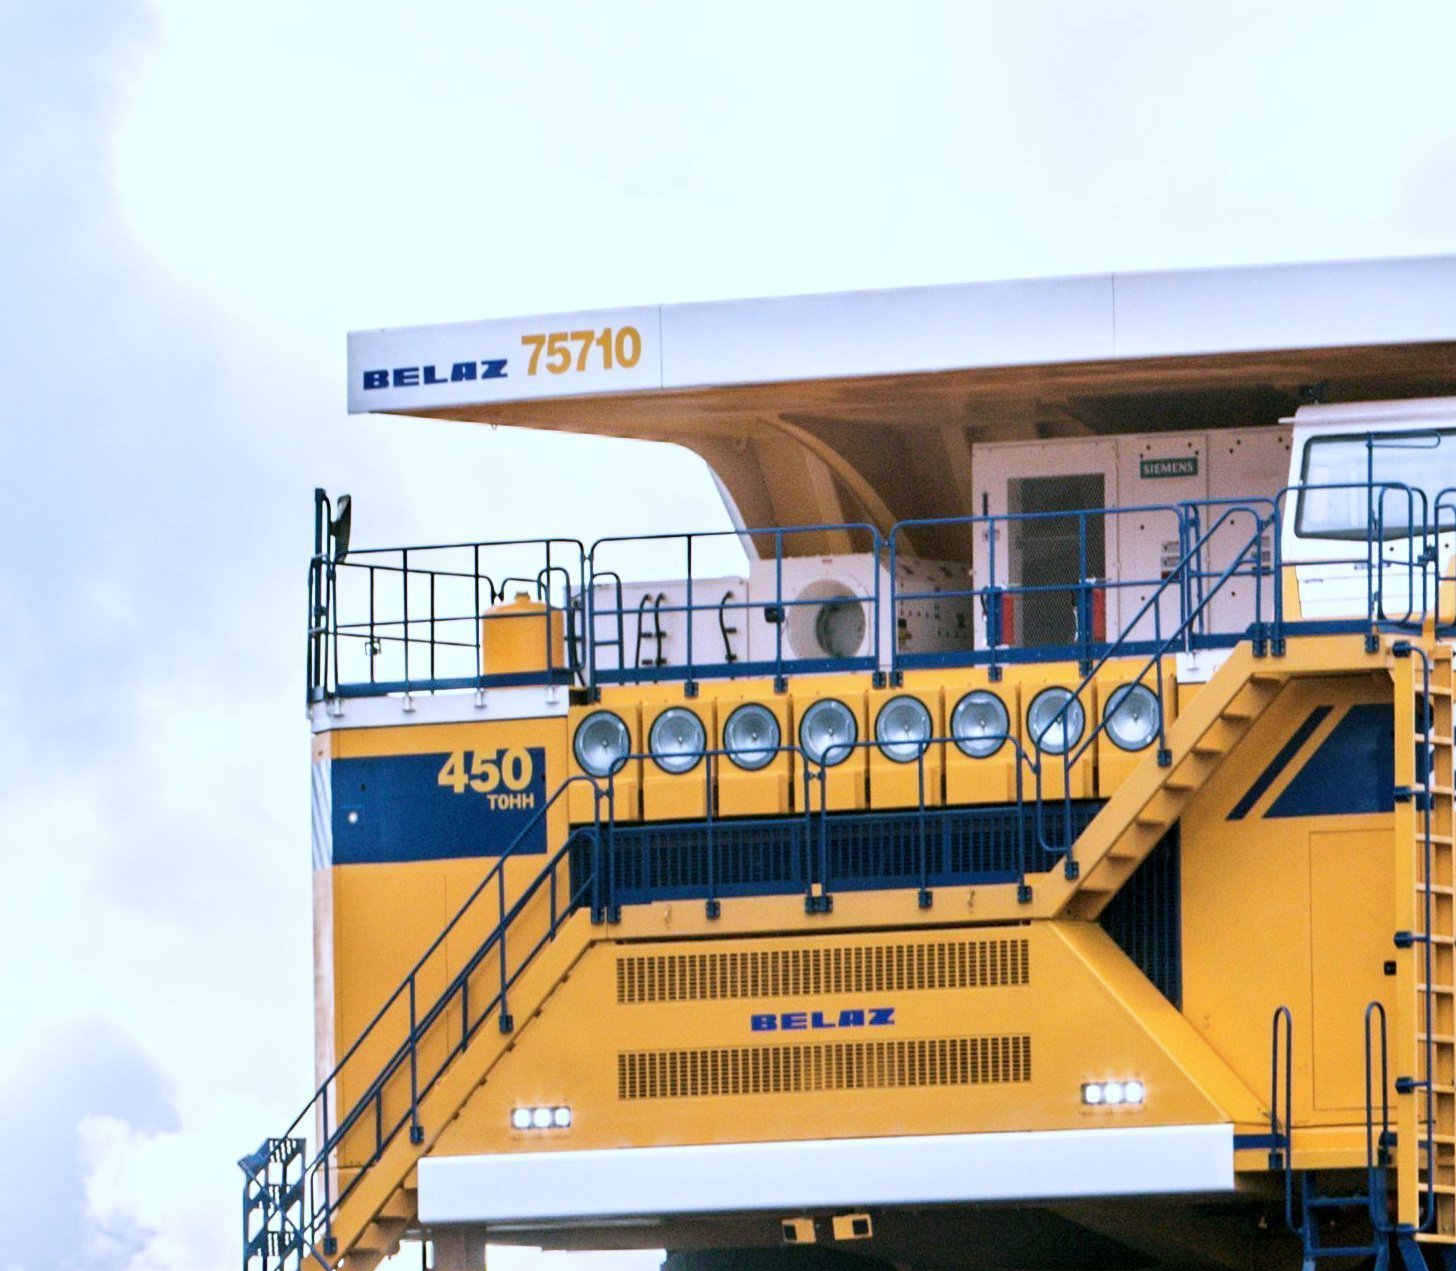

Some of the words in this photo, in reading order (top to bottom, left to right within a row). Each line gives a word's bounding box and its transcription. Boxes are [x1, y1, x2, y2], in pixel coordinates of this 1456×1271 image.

[363, 359, 508, 390] BELAZ
[521, 326, 642, 376] 75710
[1143, 461, 1194, 475] SIEMENS
[438, 746, 533, 793] 450
[486, 793, 535, 811] ТОНН
[751, 1007, 895, 1031] BELAZ
